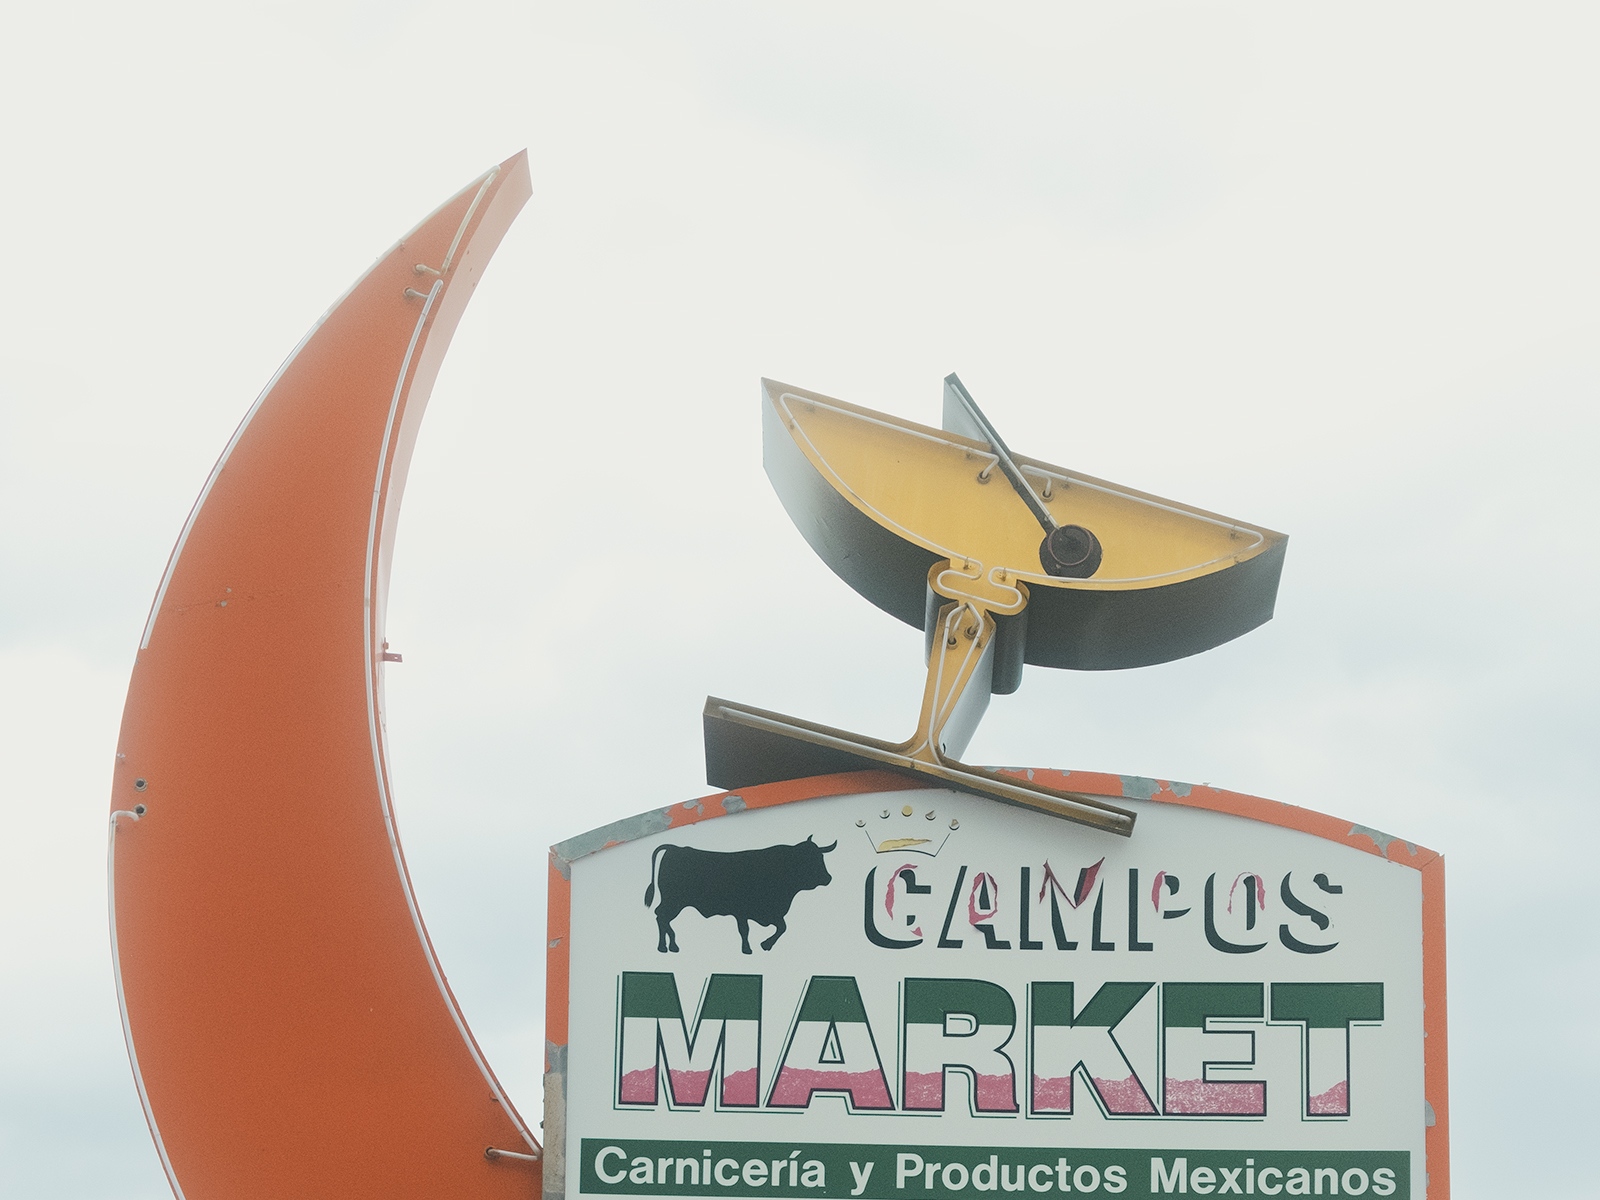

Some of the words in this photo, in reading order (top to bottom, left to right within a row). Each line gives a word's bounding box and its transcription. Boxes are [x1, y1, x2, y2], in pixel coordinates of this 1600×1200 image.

[864, 857, 1343, 954] CAMPOS
[613, 971, 1385, 1121] MARKET
[594, 1146, 827, 1189] Carnicería
[849, 1160, 873, 1196] y
[896, 1153, 1129, 1194] Productos
[1150, 1157, 1398, 1197] Mexicanos
